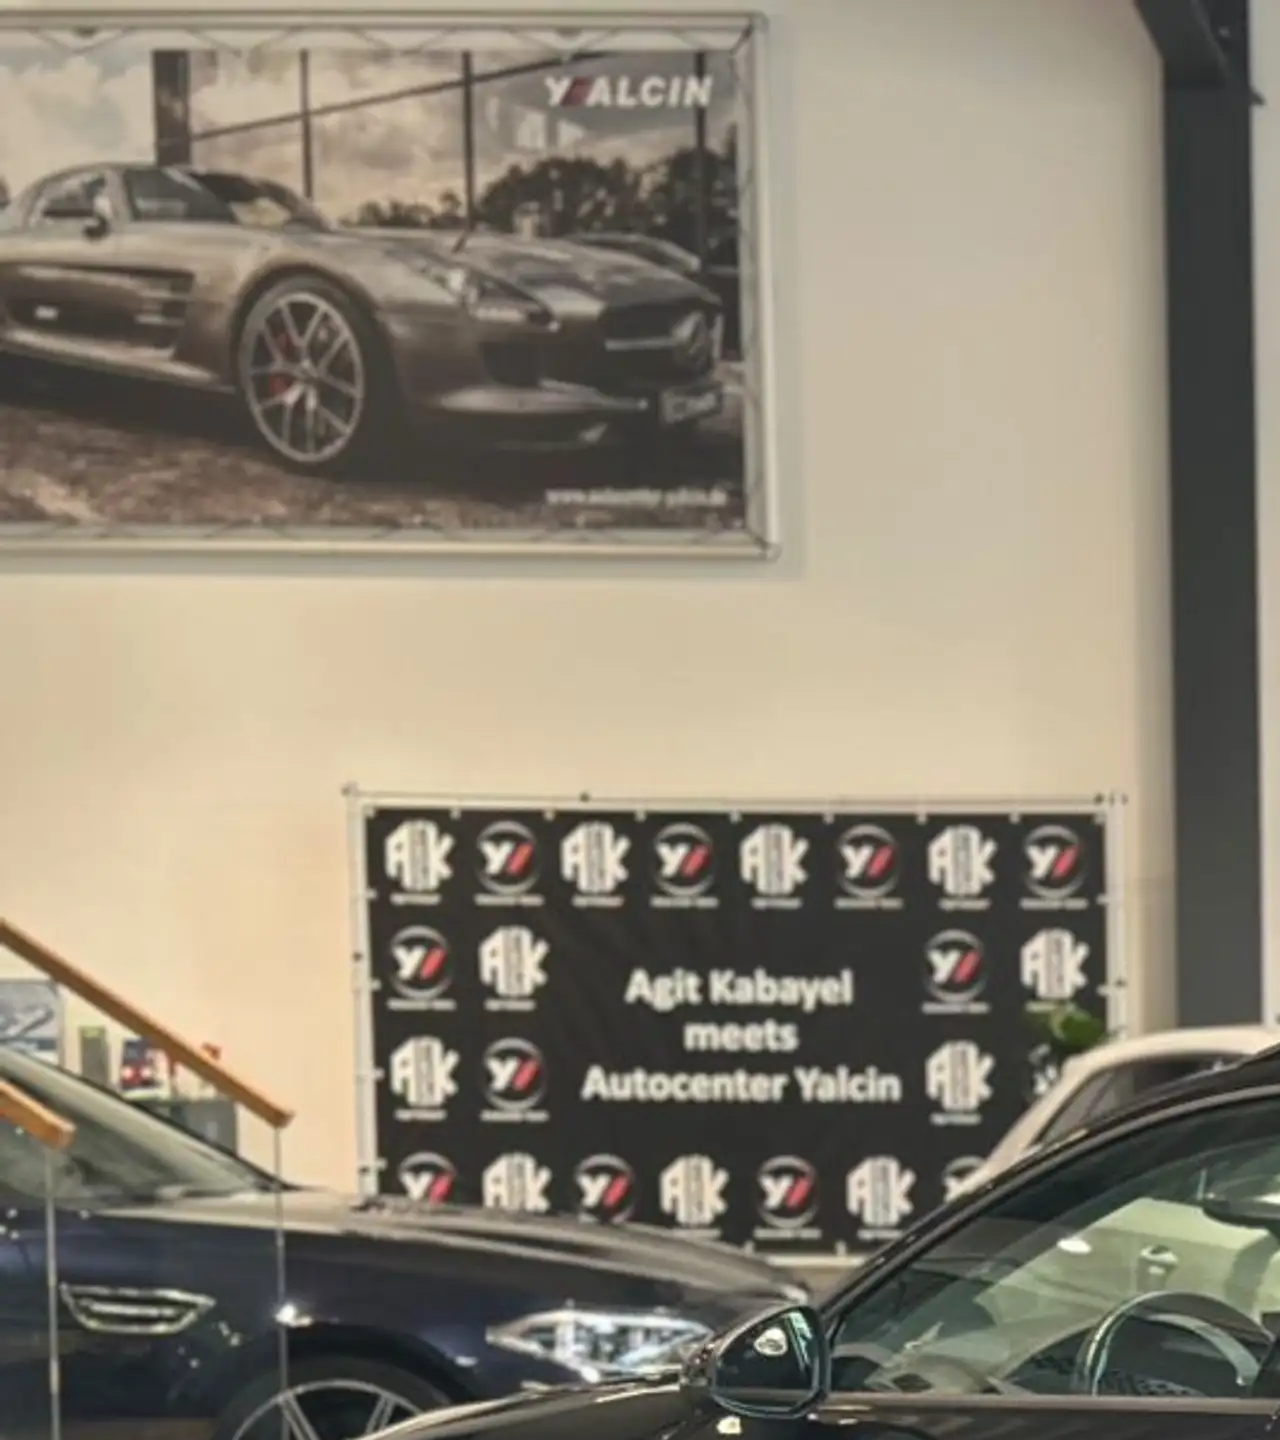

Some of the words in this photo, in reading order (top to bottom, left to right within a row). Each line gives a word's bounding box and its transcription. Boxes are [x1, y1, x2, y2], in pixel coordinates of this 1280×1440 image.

[625, 967, 702, 1012] Agit
[709, 966, 853, 1013] Kabayel
[684, 1019, 799, 1052] meets
[581, 1065, 789, 1101] Autocenter
[794, 1065, 902, 1101] Yalcin
